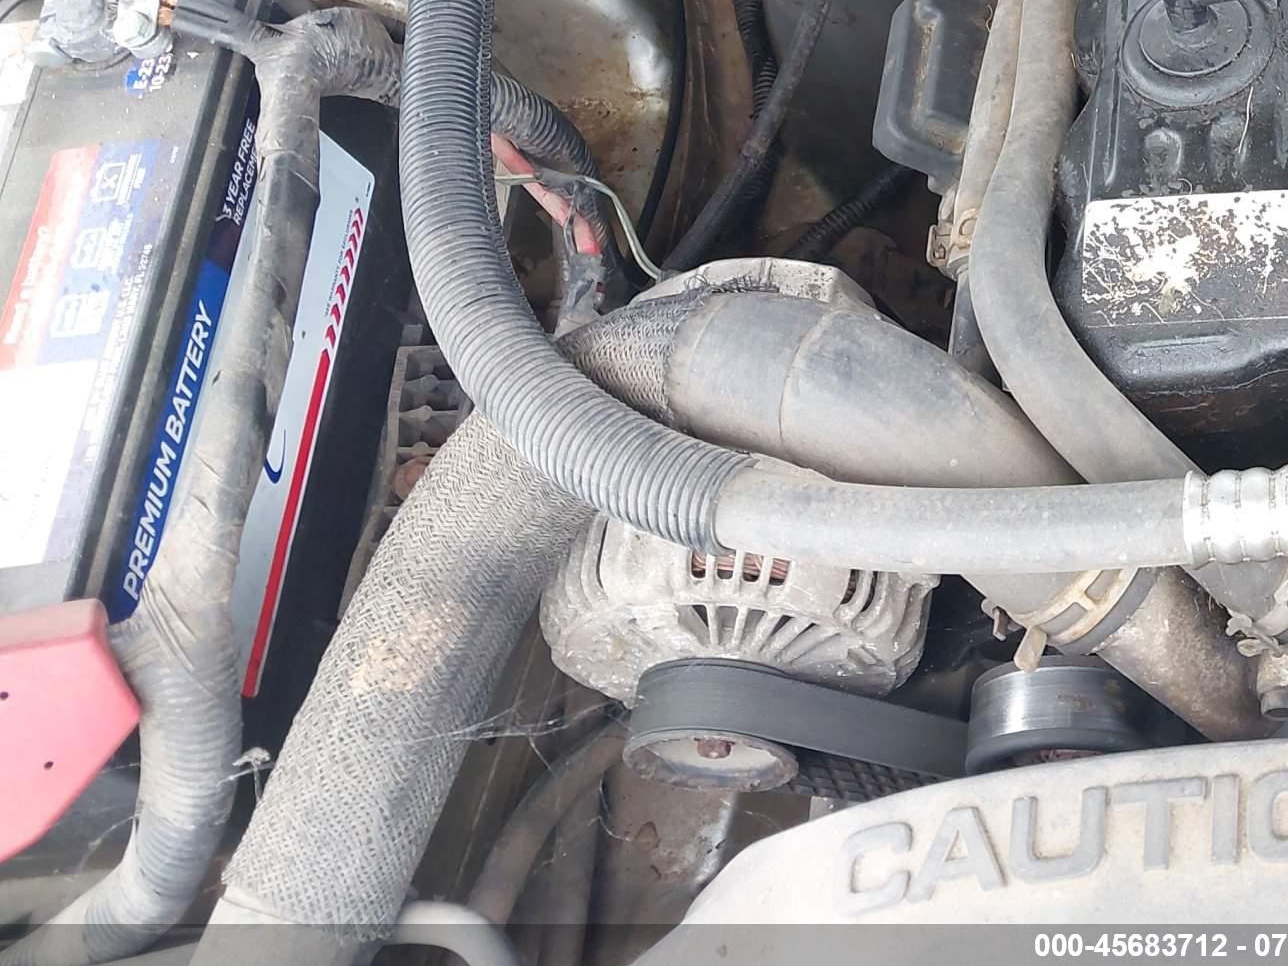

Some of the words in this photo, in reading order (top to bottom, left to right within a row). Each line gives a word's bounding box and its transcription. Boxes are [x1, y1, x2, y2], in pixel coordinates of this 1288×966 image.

[237, 117, 256, 164] FREE
[225, 161, 245, 206] YEAR
[222, 202, 233, 219] 3
[122, 440, 178, 602] PREMIUM
[164, 299, 213, 446] BATTERY
